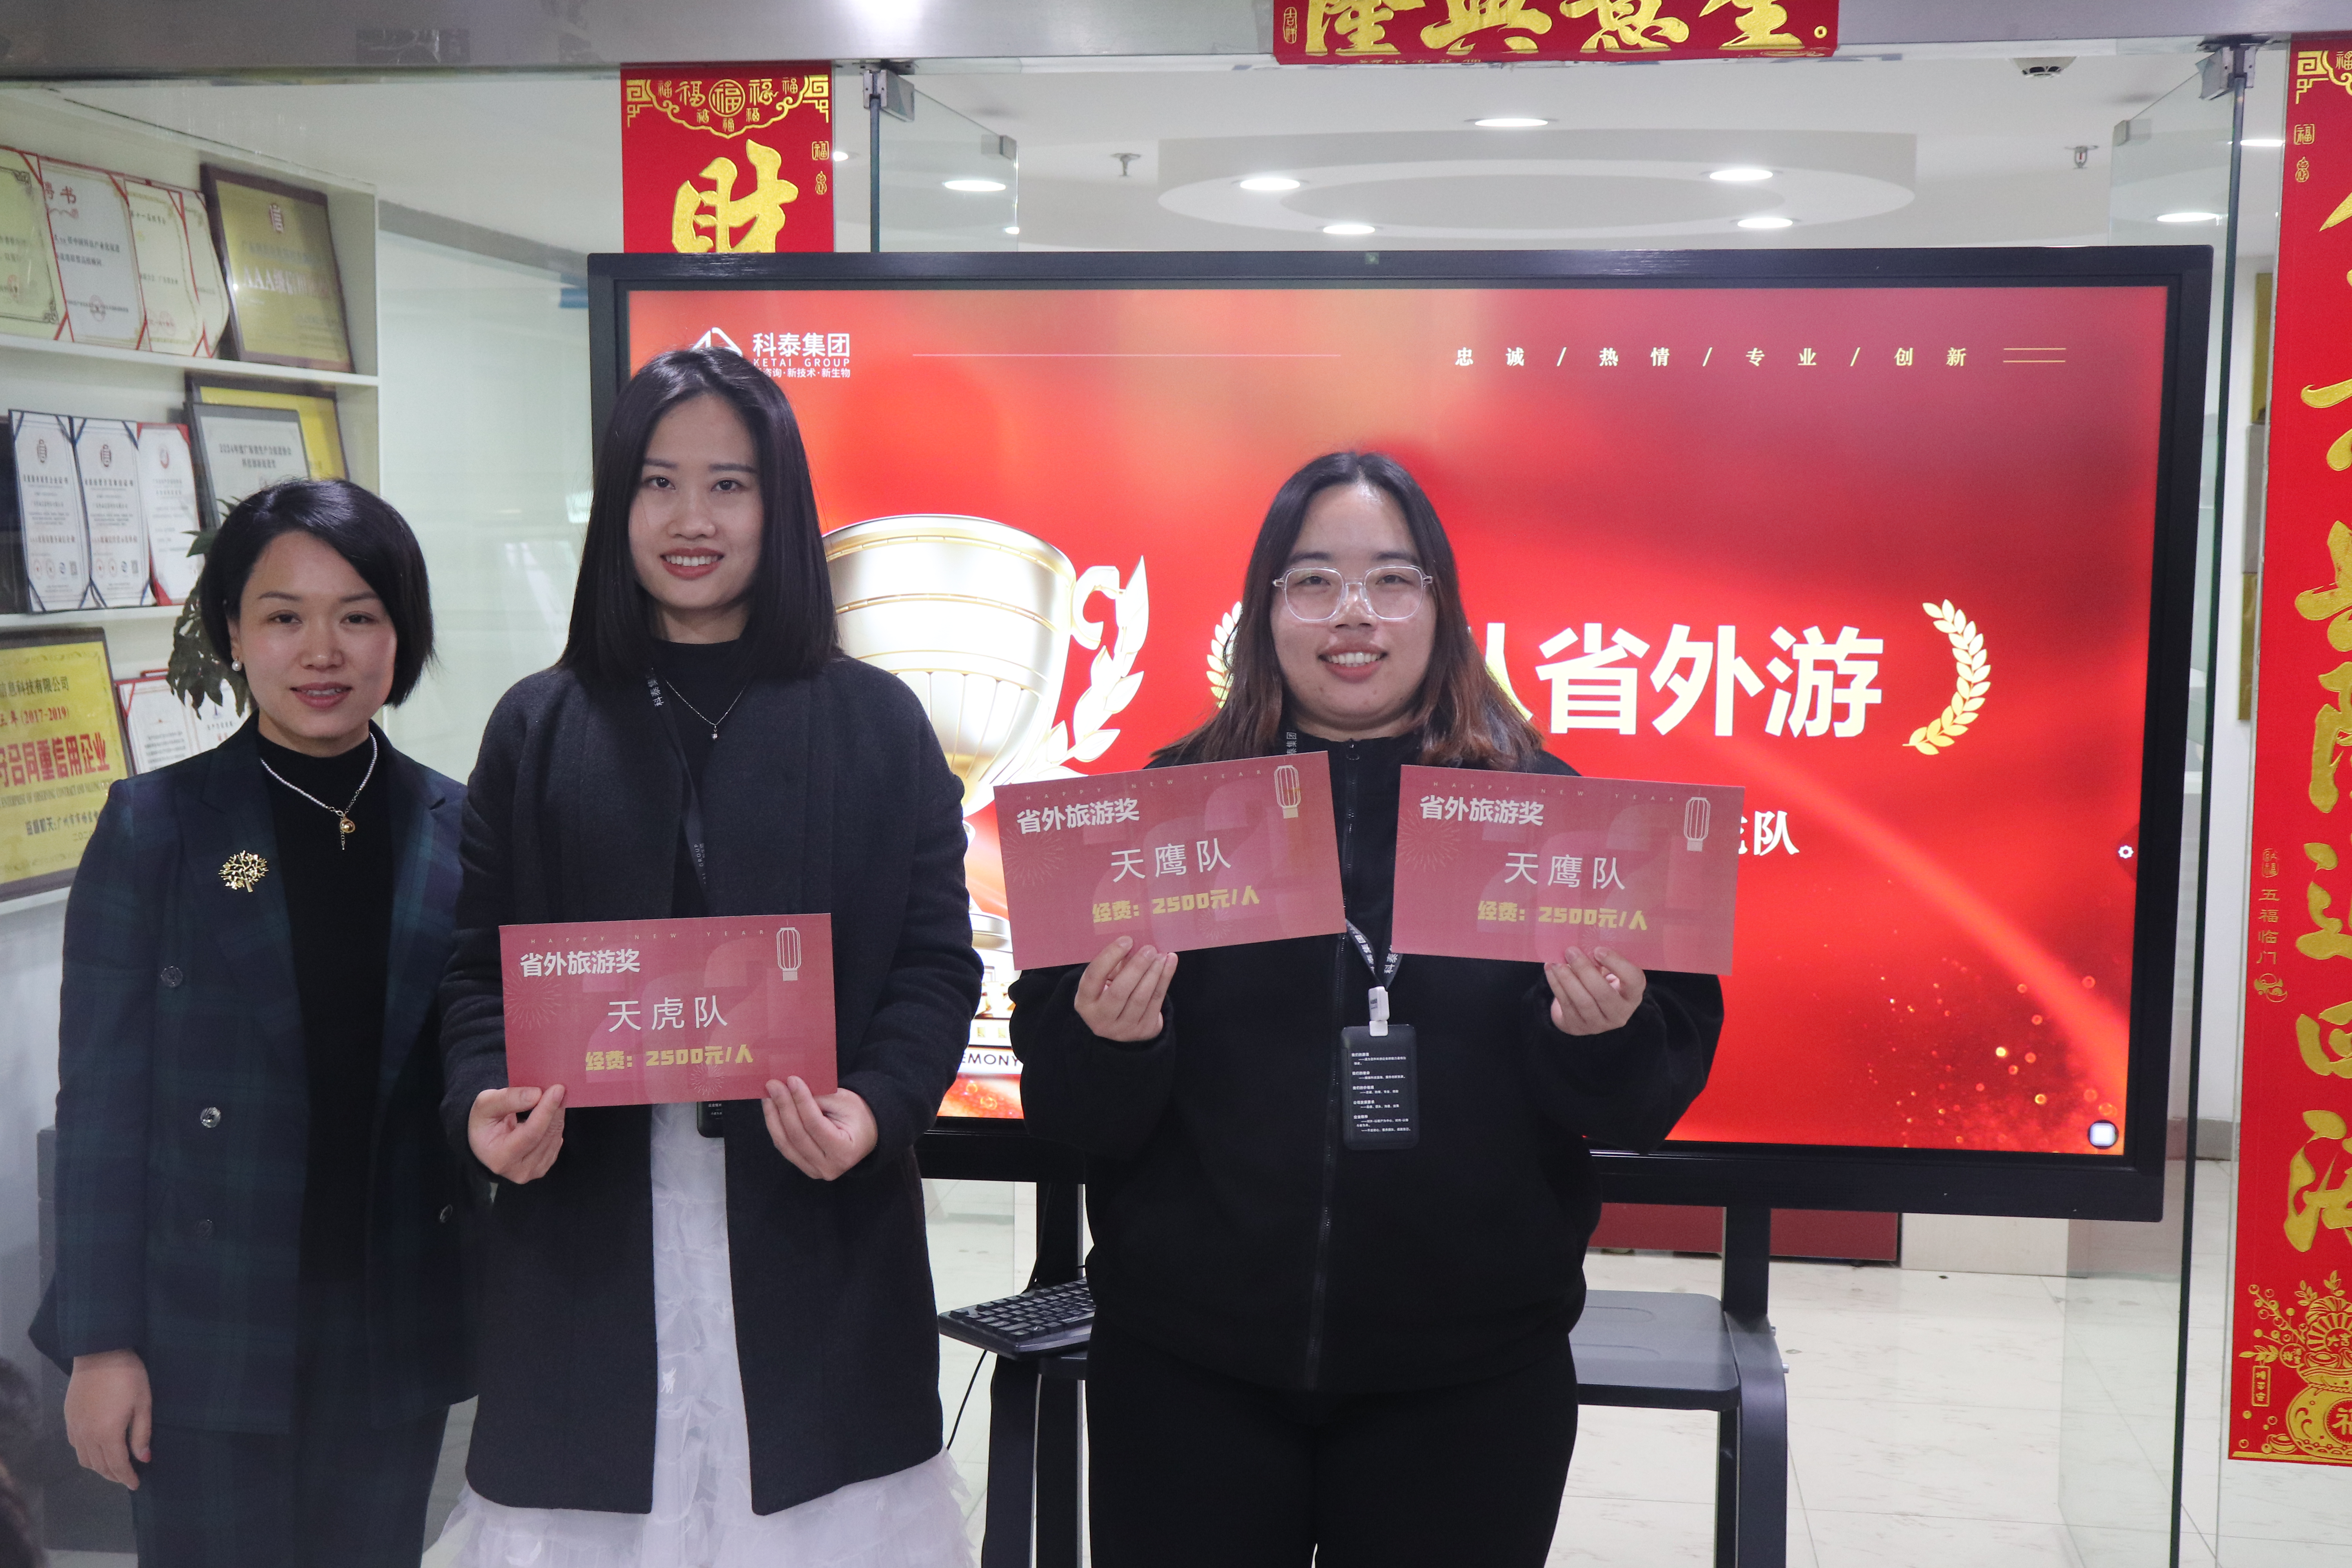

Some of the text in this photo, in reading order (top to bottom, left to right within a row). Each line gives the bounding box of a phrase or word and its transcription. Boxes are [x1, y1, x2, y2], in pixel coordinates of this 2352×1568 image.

[752, 332, 850, 357] 科泰集团
[754, 358, 850, 367] KETAI GROUP
[1025, 769, 1261, 800] HAPPY NEW YEAR
[1433, 782, 1510, 792] HAPPY
[1615, 793, 1674, 802] YEAR
[1016, 797, 1140, 835] 省外旅游奖
[1420, 795, 1545, 826] 省外旅游奖
[1738, 811, 1800, 856] 队
[1111, 838, 1231, 883] 天鹰队
[1504, 852, 1626, 890] 天鹰队
[531, 935, 604, 944] HAPPY
[2256, 889, 2281, 965] 五福临门
[520, 949, 640, 977] 省外旅游奖
[608, 995, 728, 1033] 天虎队
